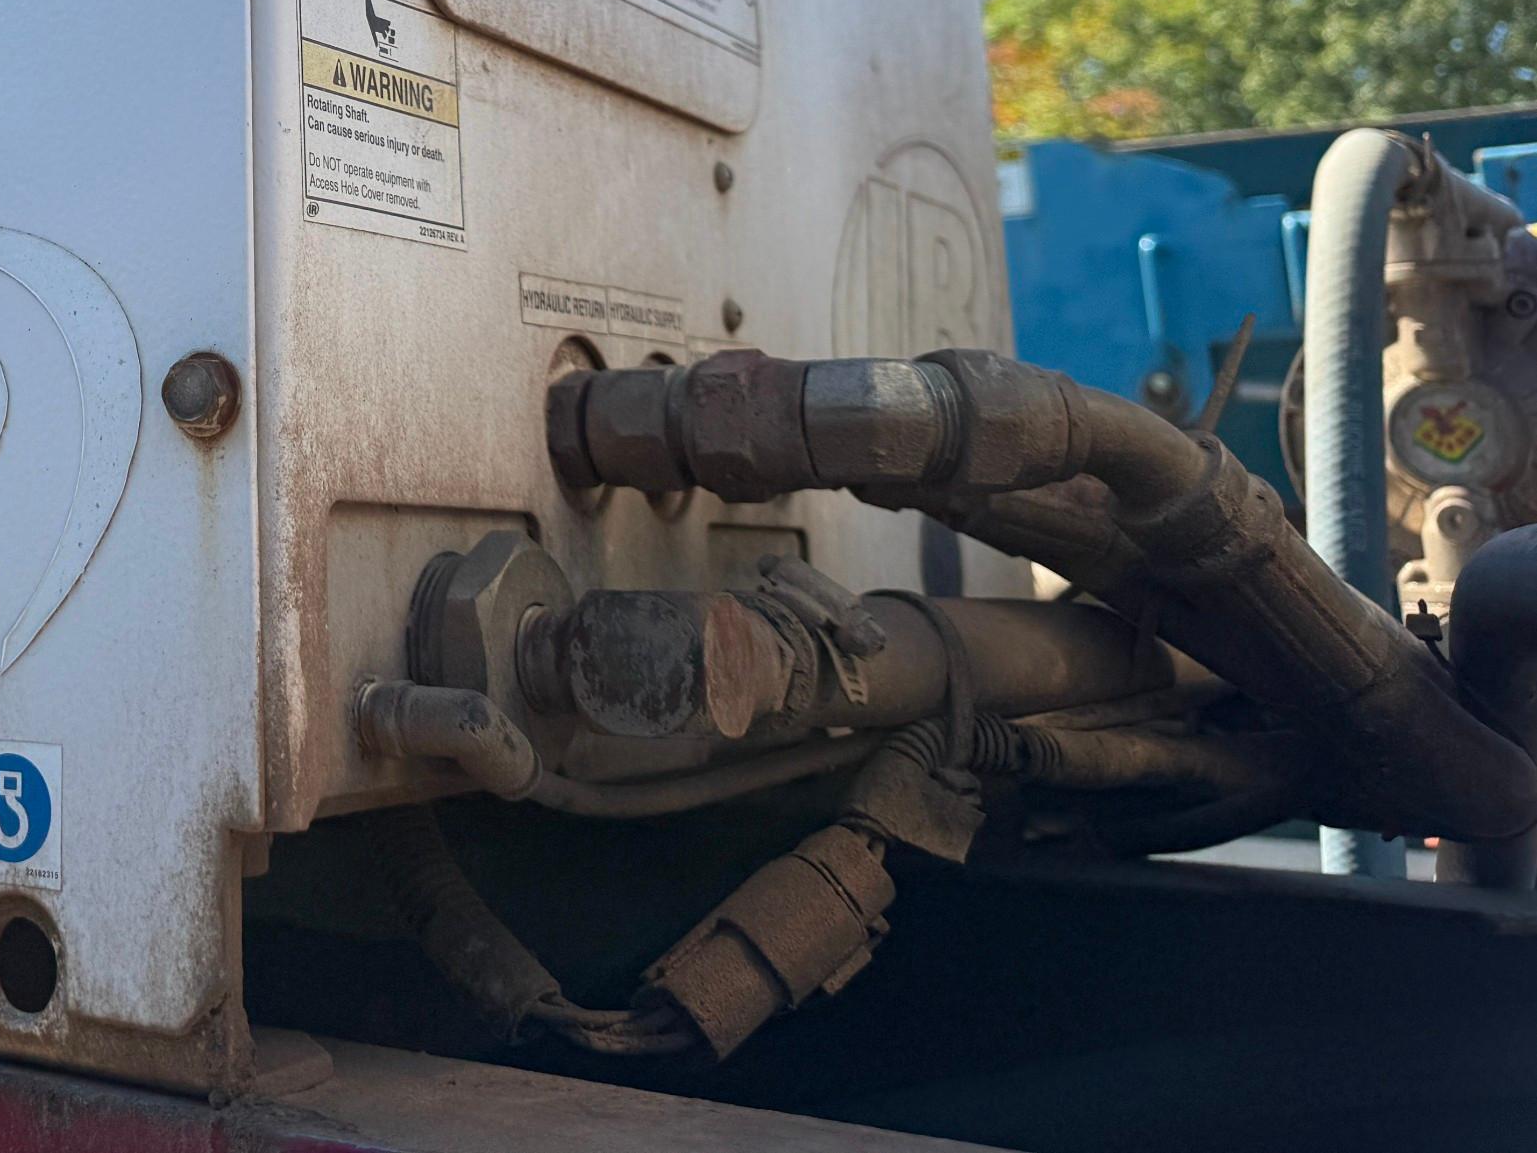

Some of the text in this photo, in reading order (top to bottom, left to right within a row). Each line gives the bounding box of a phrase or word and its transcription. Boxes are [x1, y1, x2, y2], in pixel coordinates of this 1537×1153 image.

[350, 63, 433, 111] WARNING
[307, 94, 369, 123] Rotating Shaft.
[308, 115, 445, 162] Can cause serious injury or death.
[309, 152, 431, 193] Do NOT operate equipment with
[310, 174, 420, 210] Access Hole Cover removed.
[521, 289, 605, 318] HYDRAULIC RETURN
[609, 302, 681, 330] HYDRAULIC SUPPLY
